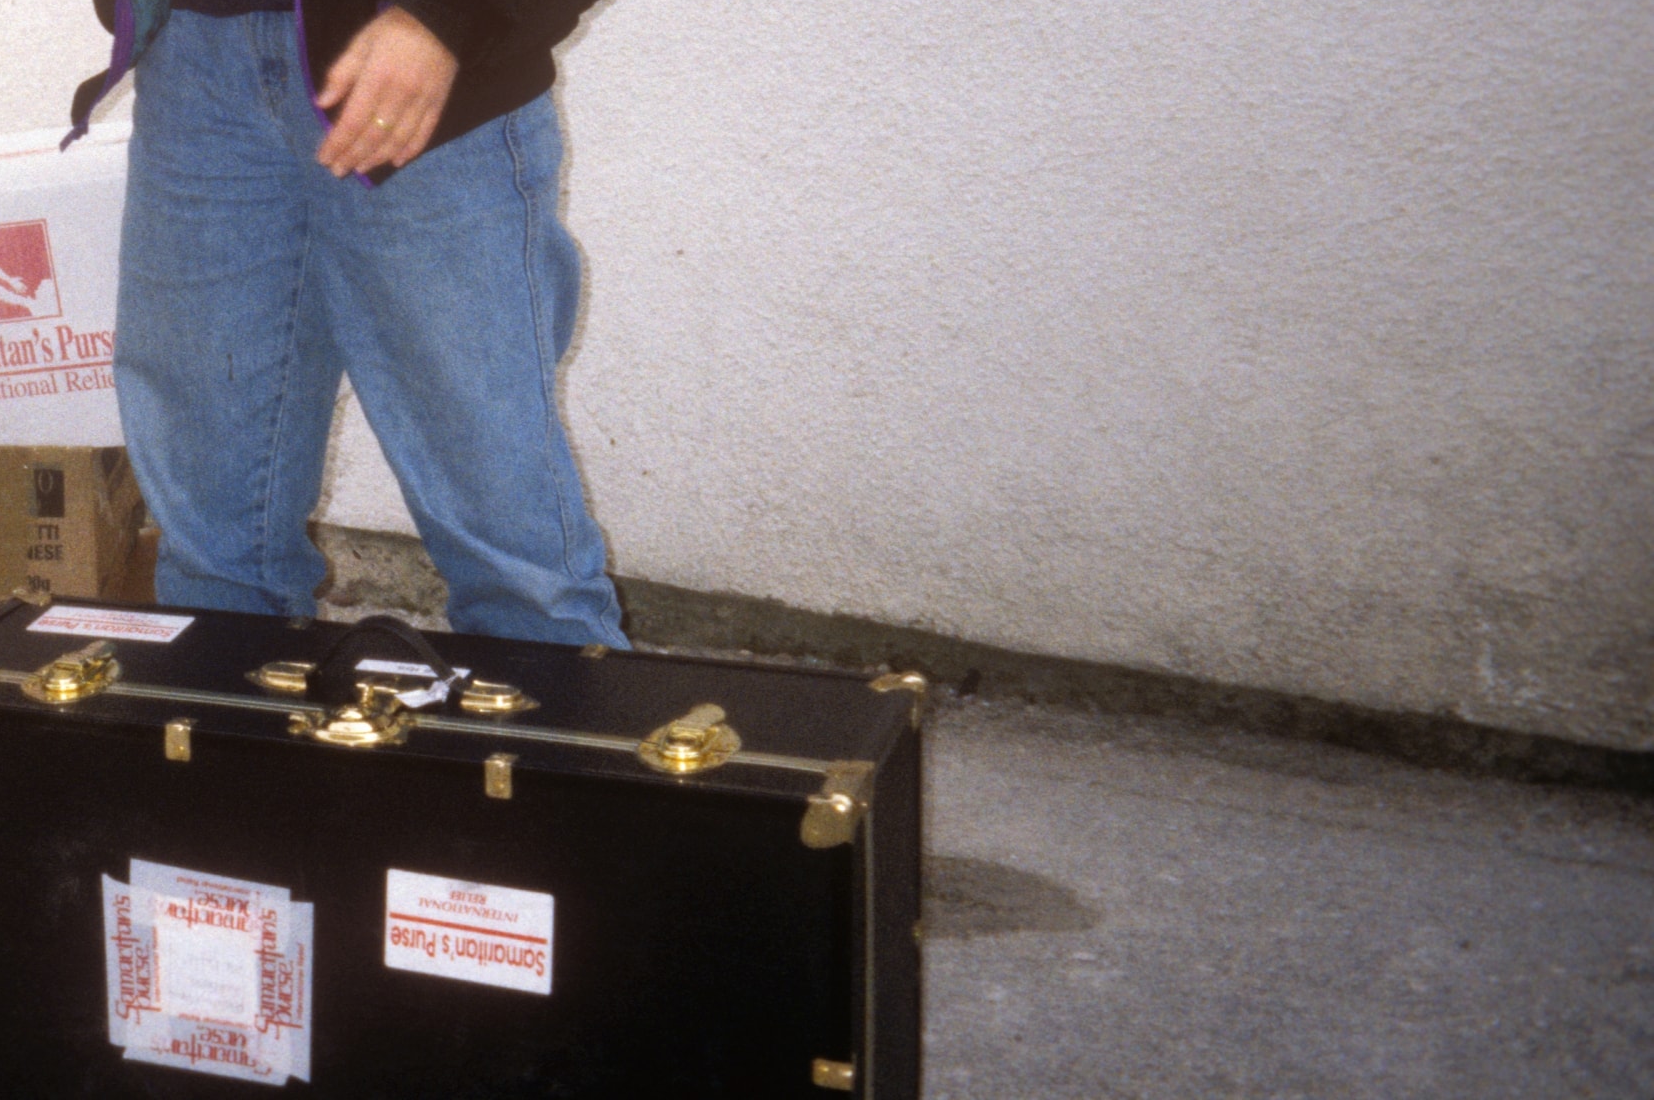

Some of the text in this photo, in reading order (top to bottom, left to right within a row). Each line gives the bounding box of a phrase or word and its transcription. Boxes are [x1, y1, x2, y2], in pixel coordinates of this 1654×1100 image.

[418, 896, 519, 923] INTERNATIONAL
[449, 890, 488, 905] RELIEF
[390, 925, 546, 977] Samaritan's Purse
